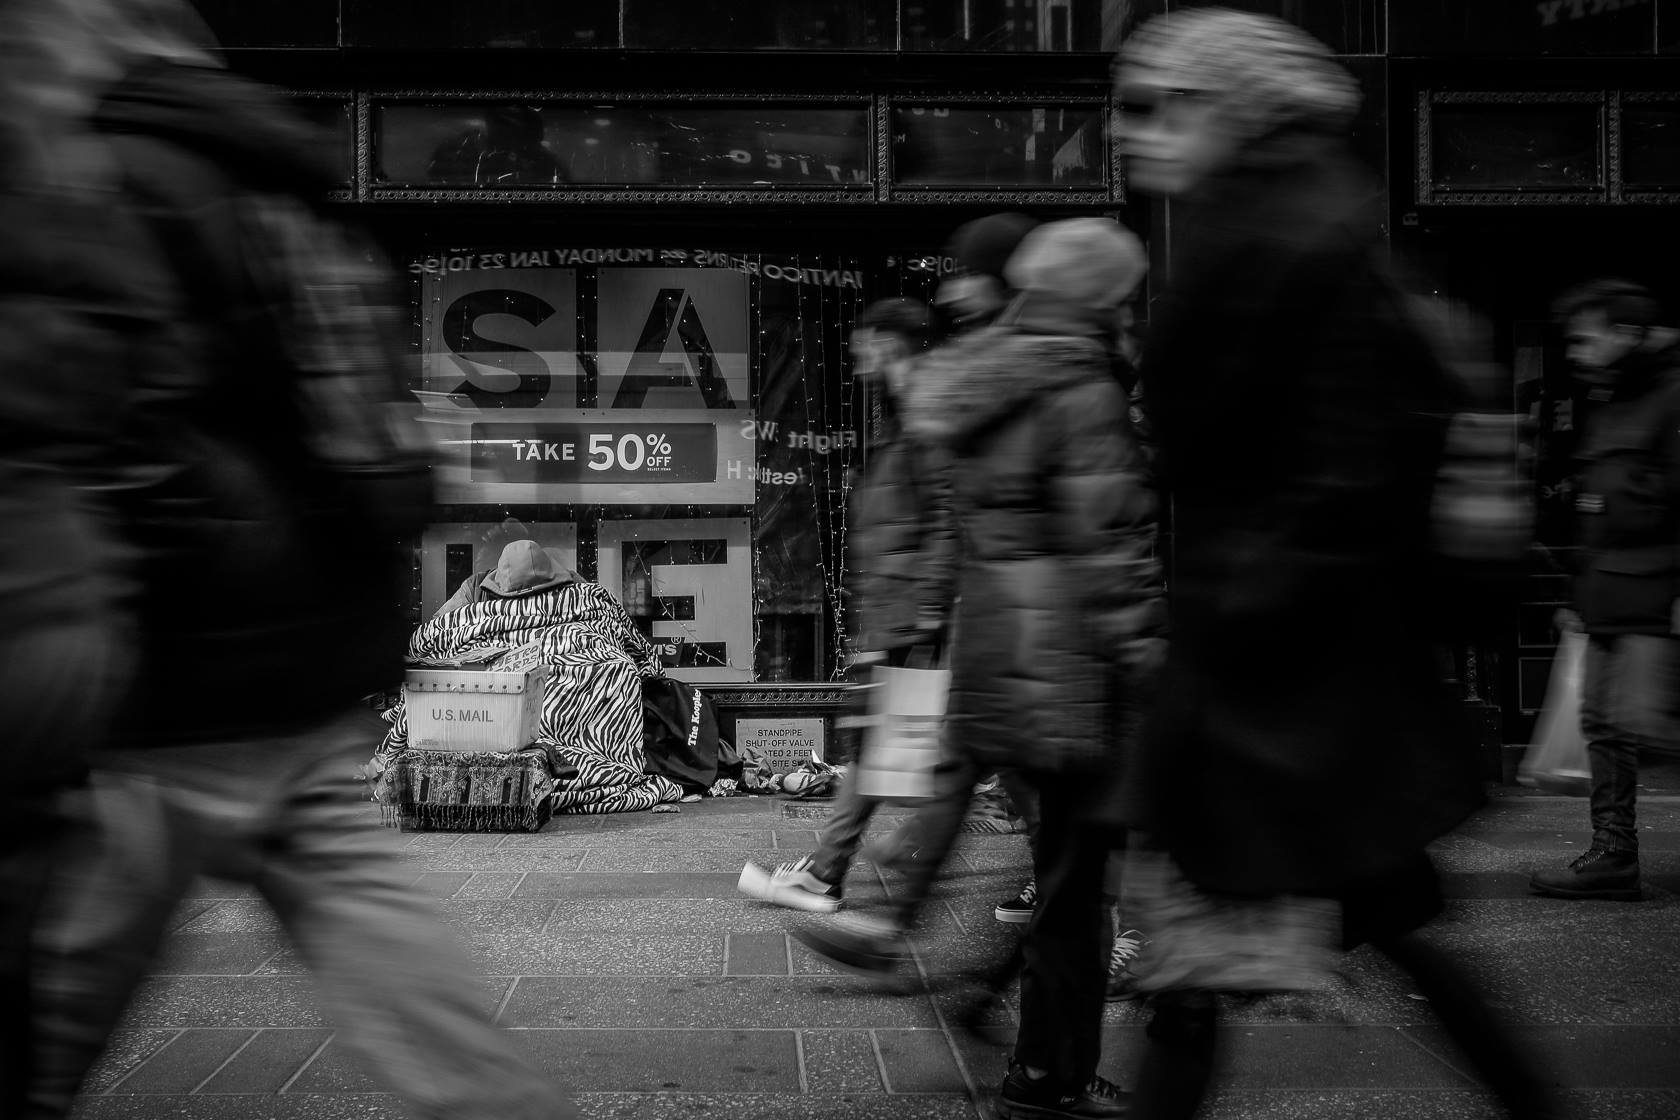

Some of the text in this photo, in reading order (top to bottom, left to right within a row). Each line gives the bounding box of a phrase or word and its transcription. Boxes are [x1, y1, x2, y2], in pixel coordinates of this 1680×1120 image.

[512, 433, 672, 471] TAKE 50%
[646, 456, 672, 467] OFF
[432, 708, 494, 723] U.S. MAIL
[687, 725, 699, 747] The
[757, 729, 803, 737] STANDPIPE
[789, 739, 815, 747] VALVE
